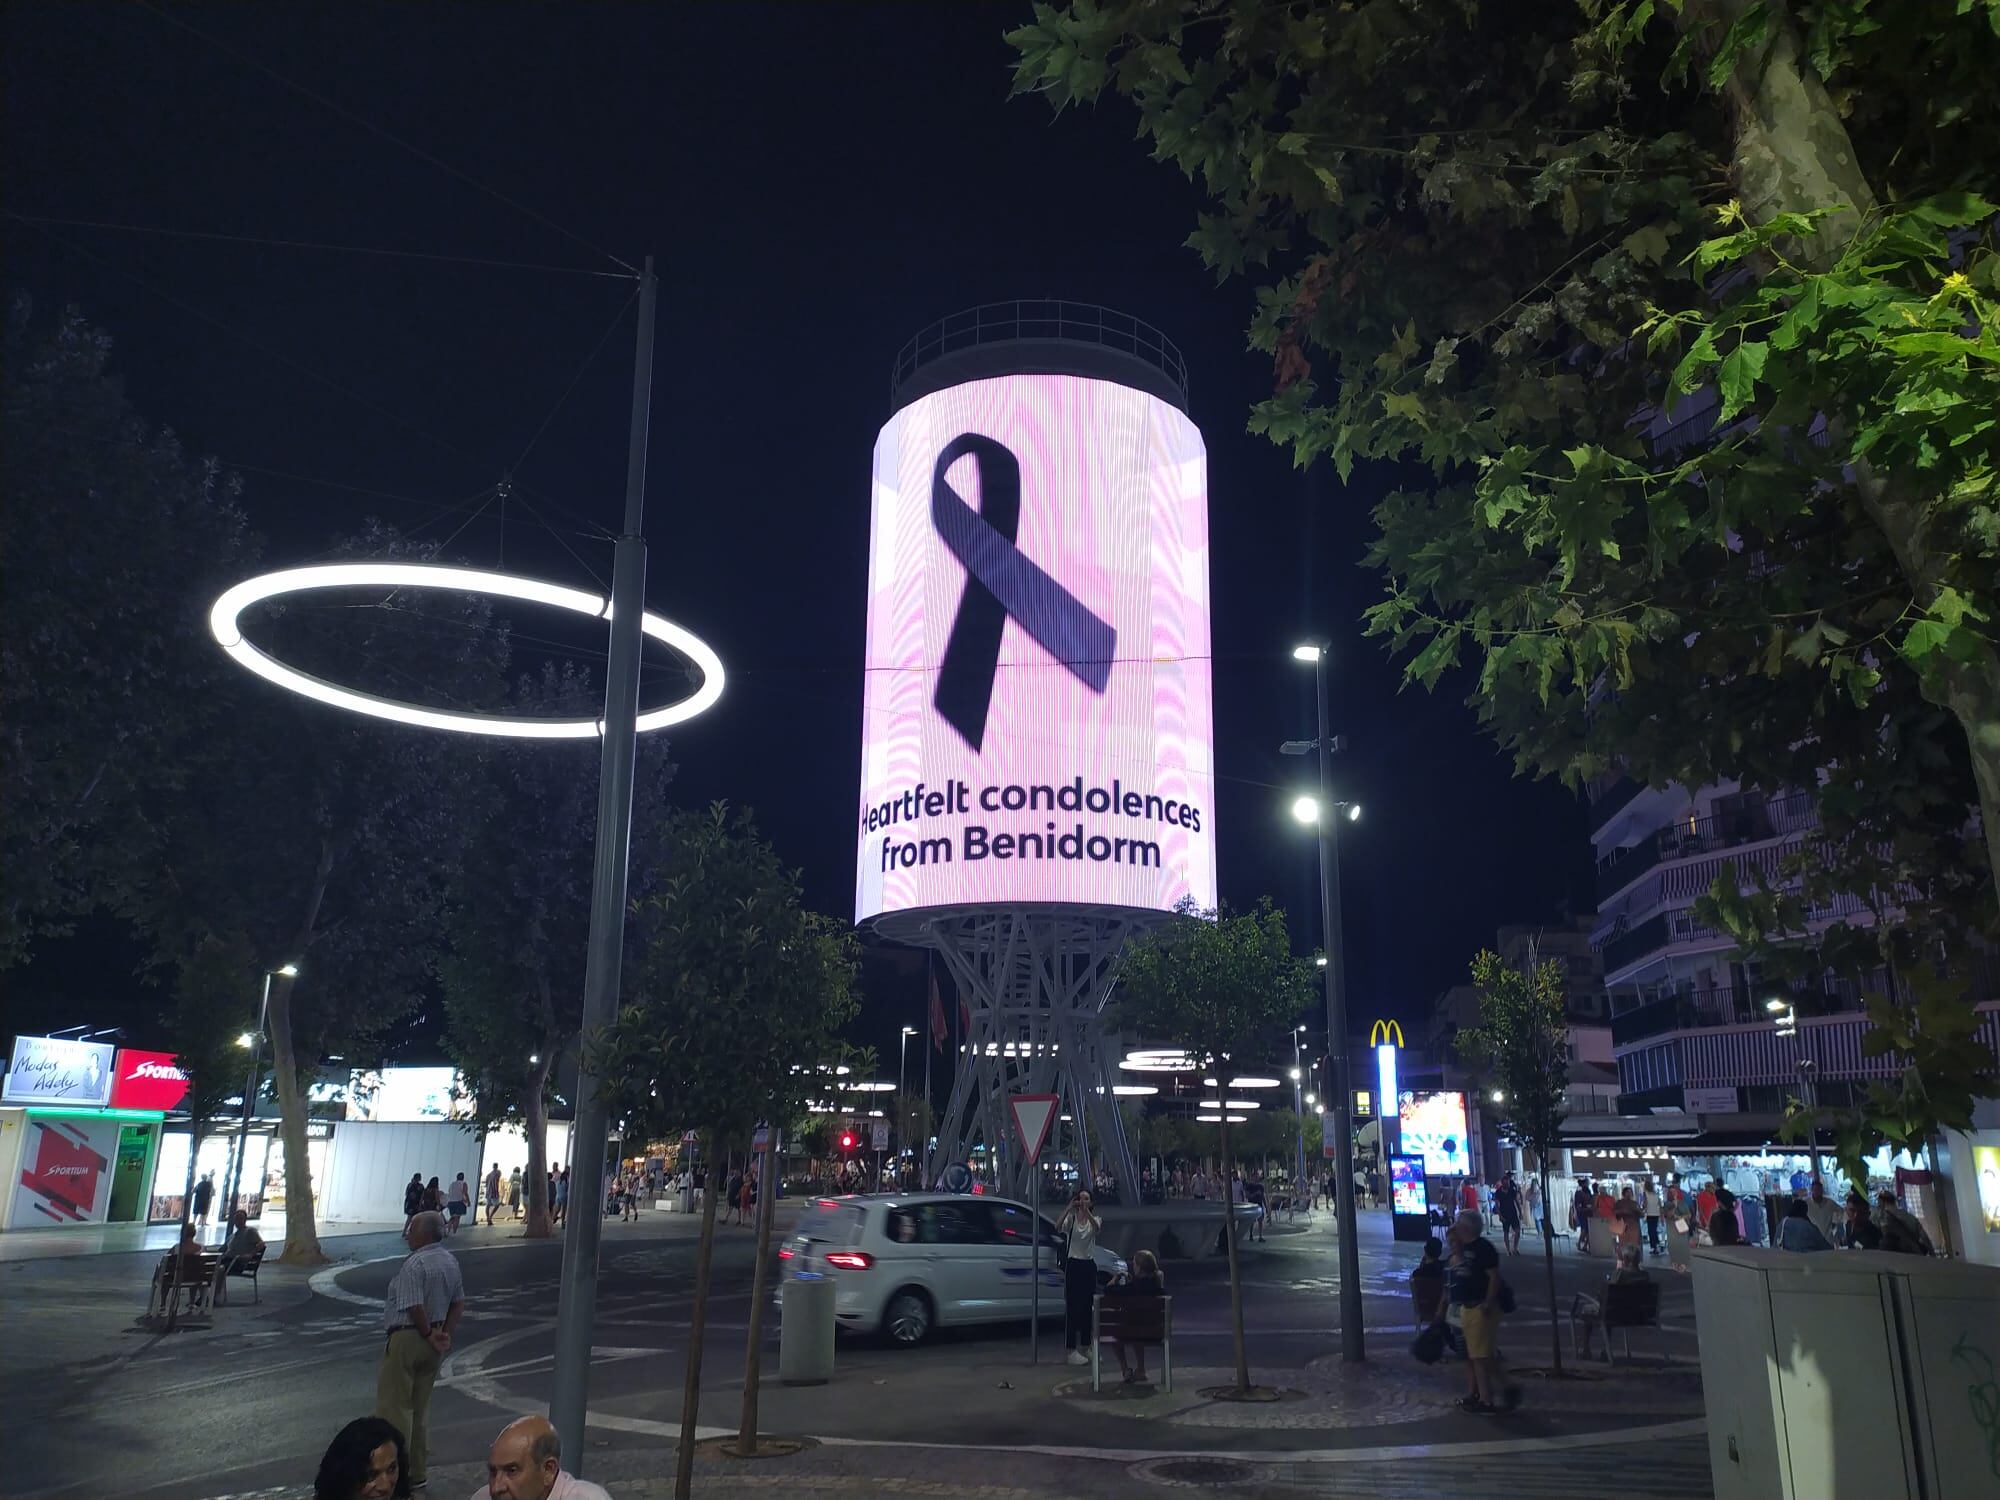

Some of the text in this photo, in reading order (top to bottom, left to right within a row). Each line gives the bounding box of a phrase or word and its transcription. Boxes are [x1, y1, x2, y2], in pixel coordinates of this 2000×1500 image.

[861, 776, 1201, 839] Heartfelt condolences
[881, 822, 1161, 873] from Benidorm
[14, 1055, 60, 1075] Modas
[125, 1060, 190, 1081] SPORTIU
[33, 1070, 80, 1097] Adely
[43, 1164, 89, 1177] SPORTIUM
